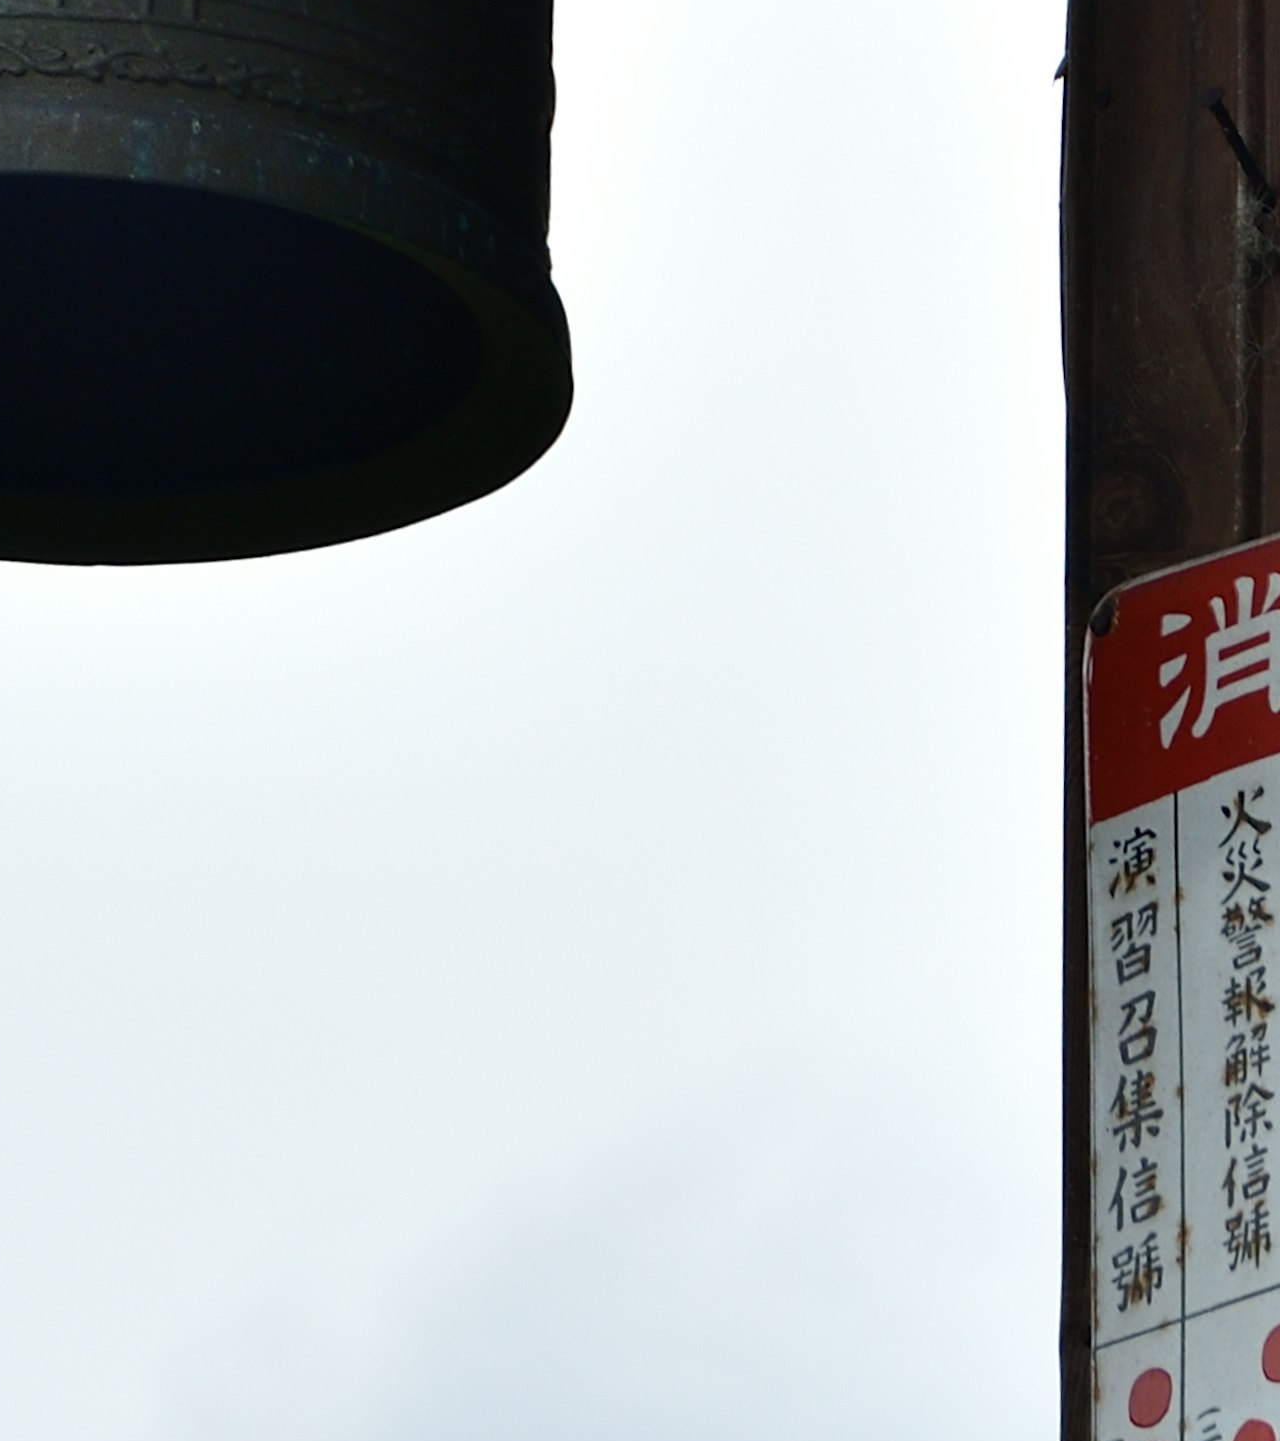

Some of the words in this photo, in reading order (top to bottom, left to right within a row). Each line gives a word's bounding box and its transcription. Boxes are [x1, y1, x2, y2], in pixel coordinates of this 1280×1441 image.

[1106, 826, 1164, 1313] 演習召集信號
[1216, 783, 1276, 1273] 火災警報解除信號
